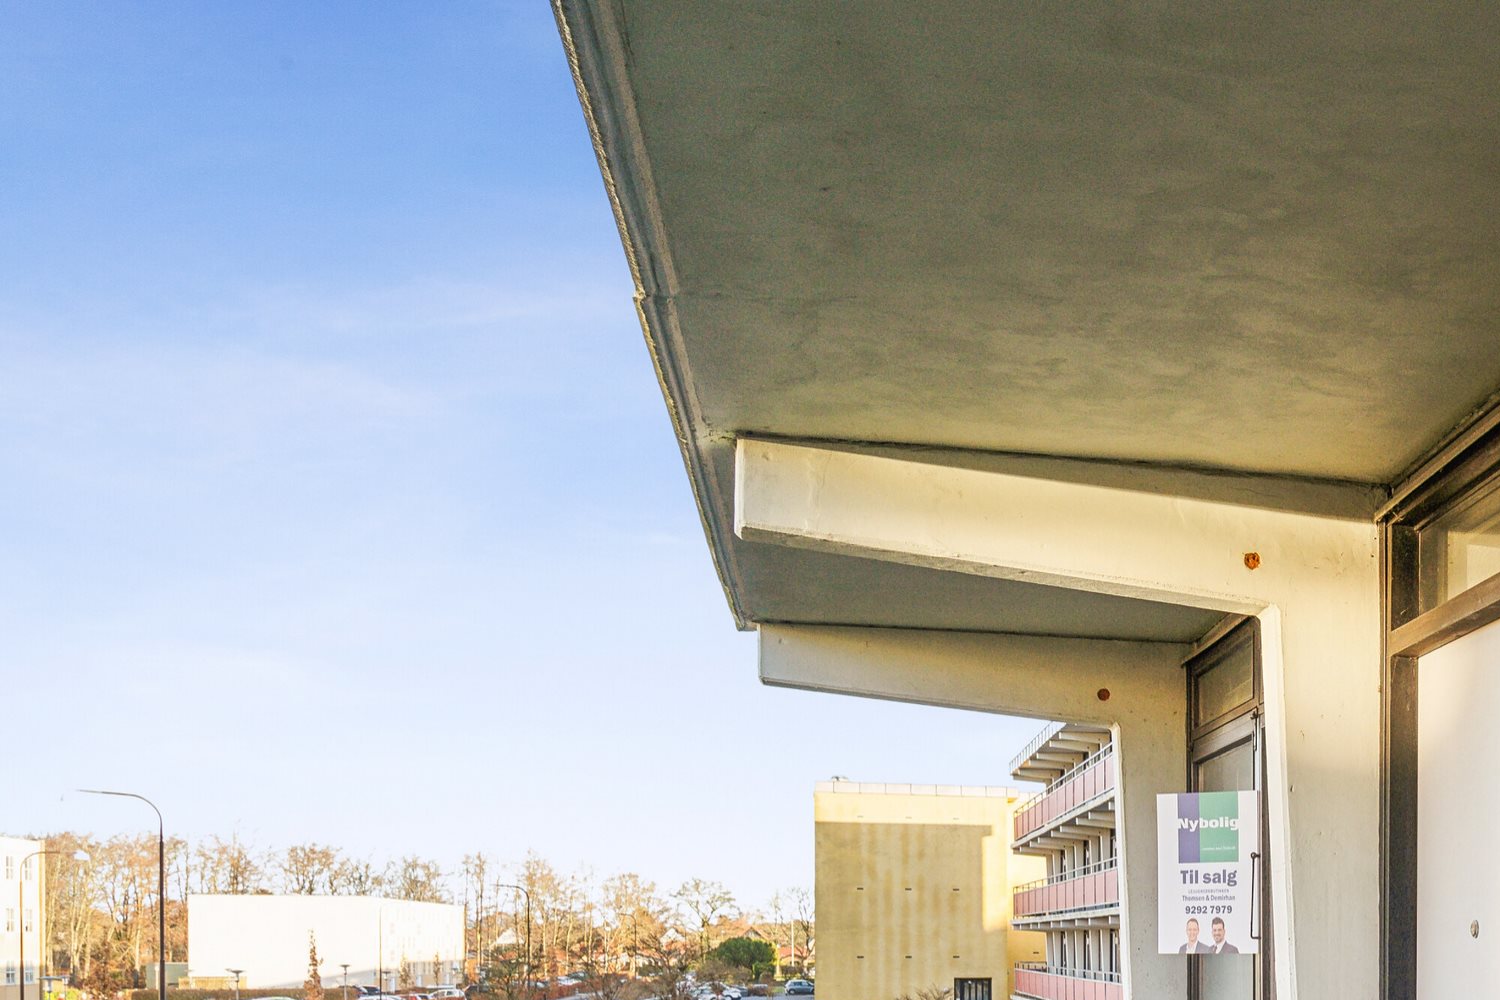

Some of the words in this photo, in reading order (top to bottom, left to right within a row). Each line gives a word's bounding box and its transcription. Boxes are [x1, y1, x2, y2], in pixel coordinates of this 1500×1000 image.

[1178, 816, 1240, 832] Nybolig
[1180, 870, 1199, 884] Til
[1202, 869, 1238, 887] salg
[1185, 905, 1208, 914] 9292
[1209, 905, 1233, 914] 7979
